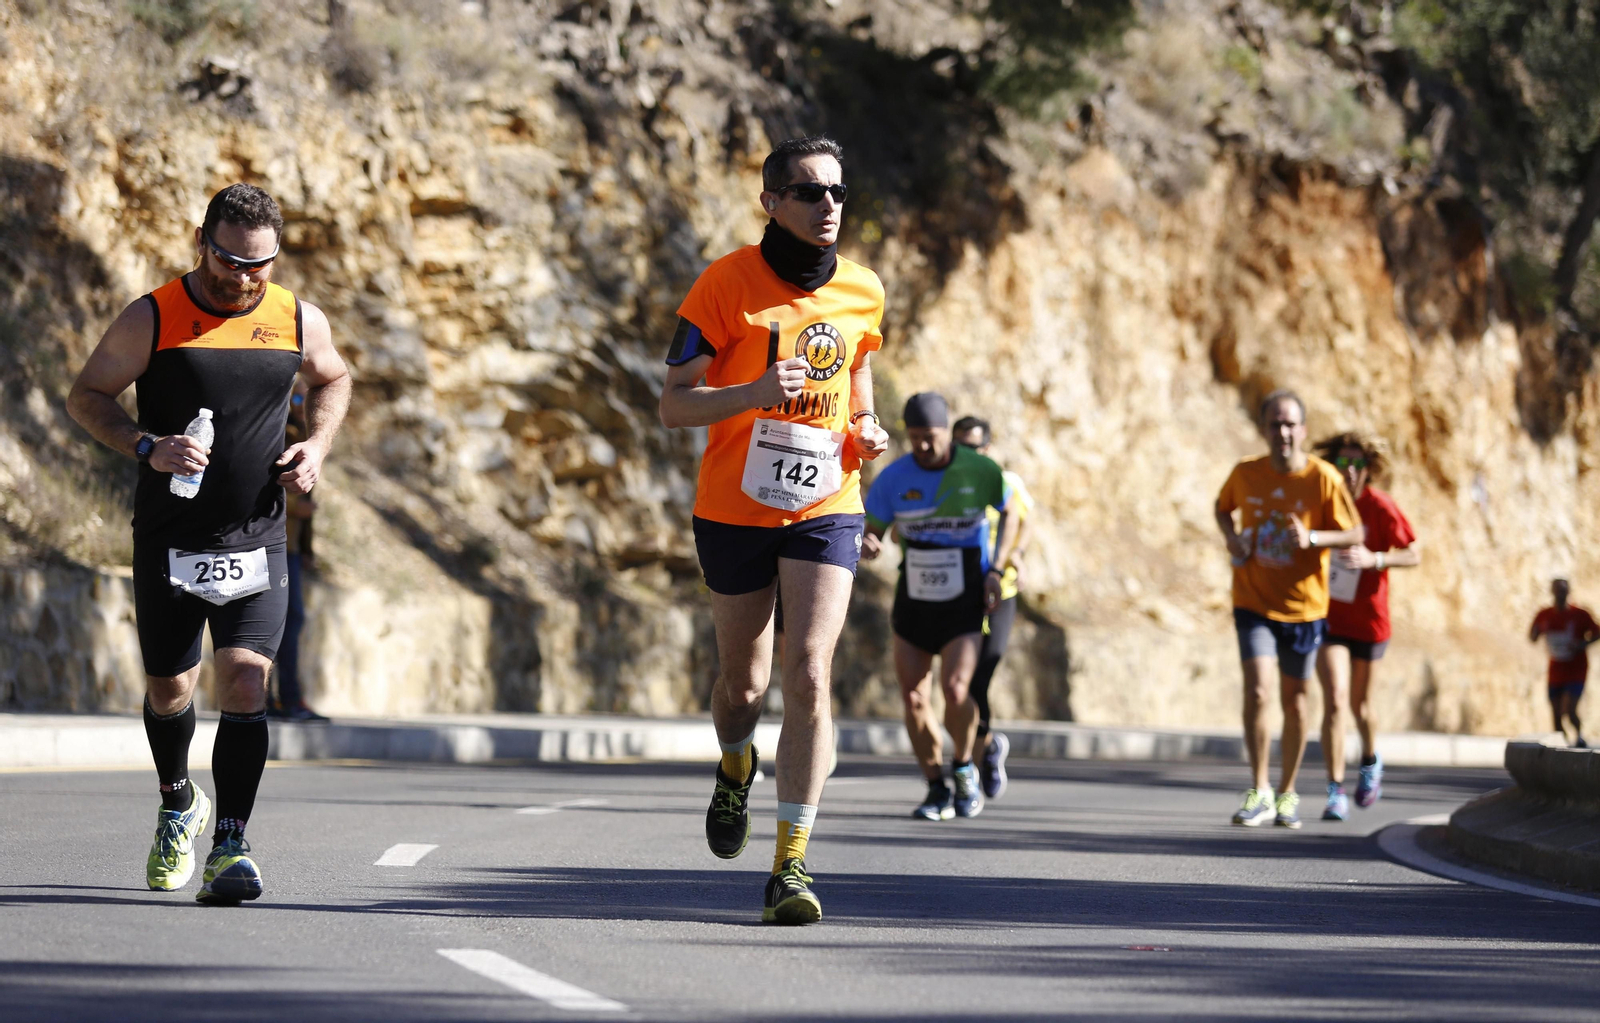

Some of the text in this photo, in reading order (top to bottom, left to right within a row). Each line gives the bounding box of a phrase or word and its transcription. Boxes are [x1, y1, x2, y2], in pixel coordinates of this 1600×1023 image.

[807, 324, 838, 339] BEER
[772, 459, 818, 488] 142
[194, 558, 244, 584] 255
